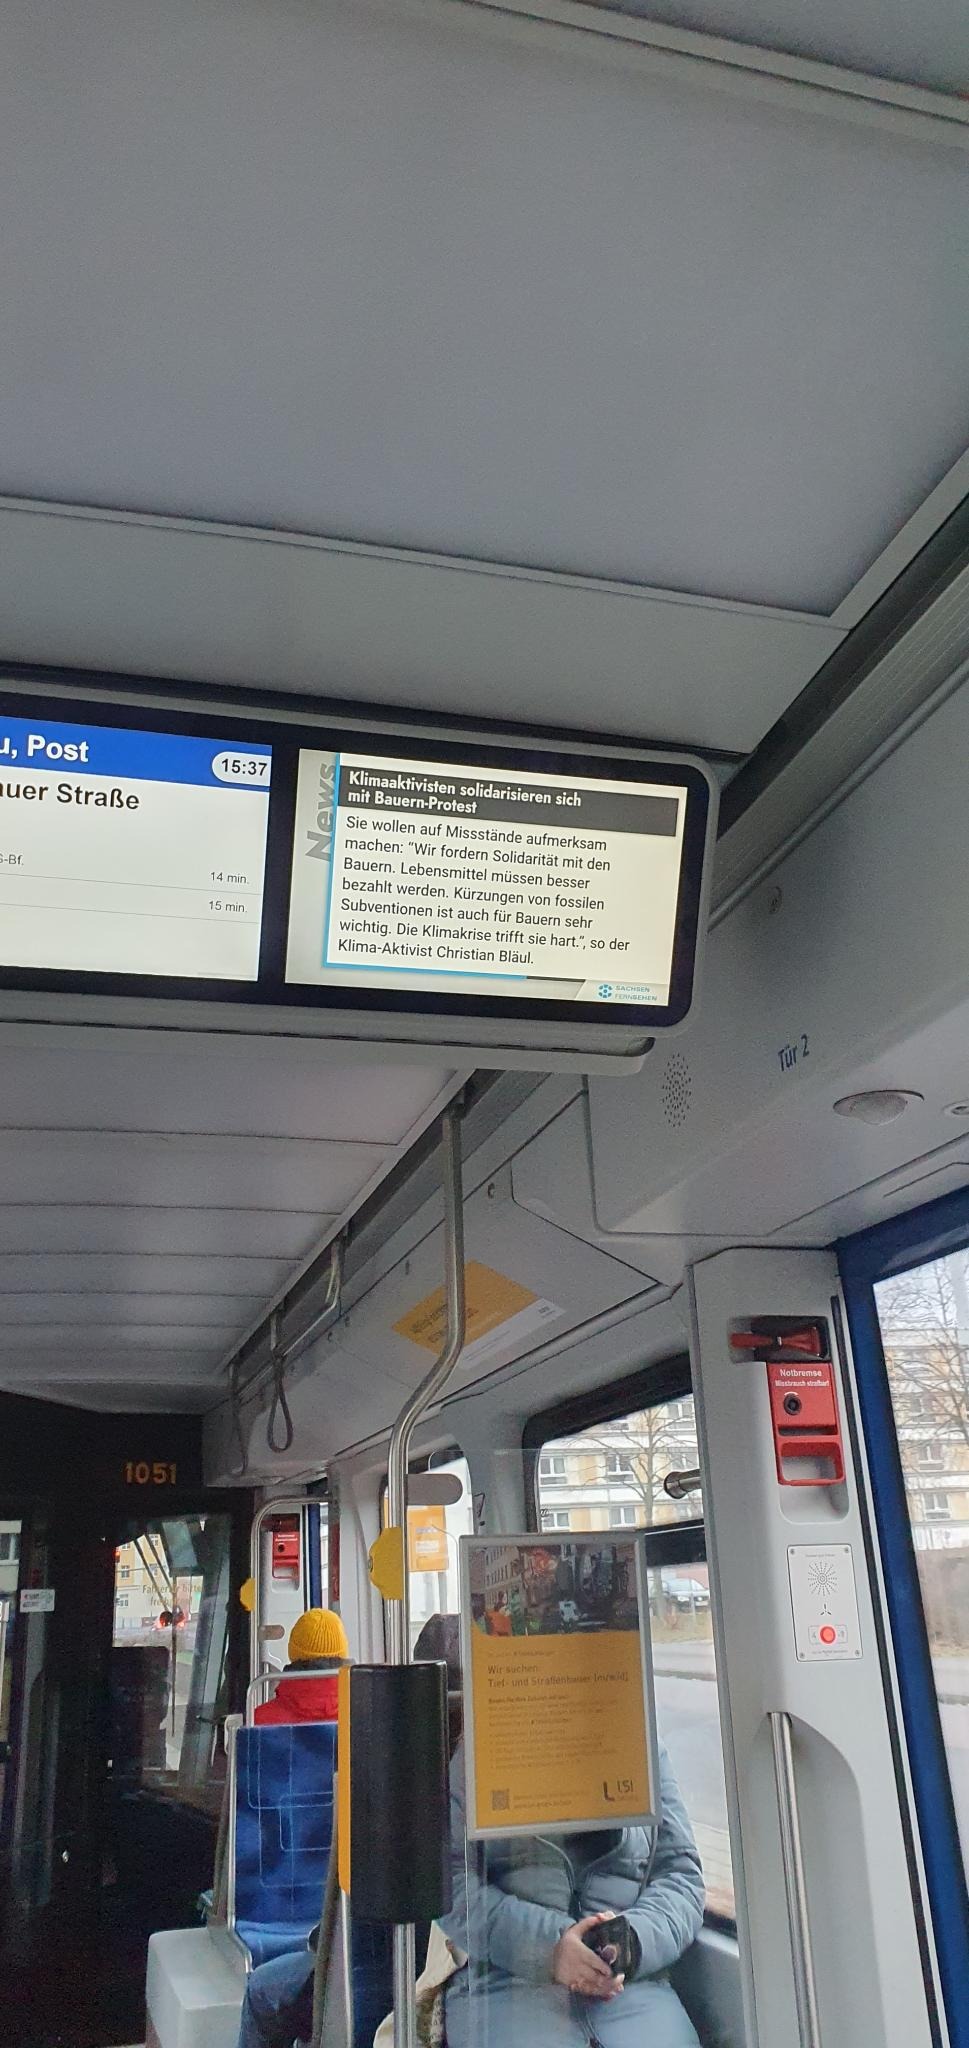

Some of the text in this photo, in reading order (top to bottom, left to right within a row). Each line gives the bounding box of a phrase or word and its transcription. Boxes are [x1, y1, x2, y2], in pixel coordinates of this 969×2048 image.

[27, 734, 90, 763] Post
[221, 758, 268, 777] 15:37
[0, 783, 140, 810] uer Straße
[348, 789, 477, 814] mit Bauern-Protest
[349, 771, 582, 807] Klimaaktivisten solidarisieren sich
[305, 763, 336, 862] News
[346, 816, 607, 851] Sie wollen auf Missstände aufmerksam
[345, 838, 403, 854] machen:
[441, 845, 488, 861] fordern
[492, 849, 559, 867] Solidarität
[562, 856, 583, 869] mit
[587, 857, 611, 871] den
[210, 871, 250, 885] 14 min.
[343, 857, 590, 889] Bauern. Lebensmittel müssen besser
[209, 901, 248, 913] 15 min.
[342, 877, 605, 910] bezahlt werden. Kürzungen von fossilen
[341, 898, 593, 929] Subventionen ist auch für Bauern sehr
[339, 919, 392, 937] wichtig.
[397, 922, 418, 936] Die
[422, 925, 492, 942] Klimakrise
[495, 929, 525, 944] trifft
[528, 933, 547, 946] sie
[590, 938, 606, 950] so
[609, 937, 630, 951] der
[338, 938, 534, 965] Klima-Aktivist Christian Bläul.
[615, 985, 650, 993] SACHSEN
[615, 993, 658, 1002] FERNSEHEN
[778, 1033, 810, 1072] Tür 2
[780, 1368, 823, 1377] Notbremse
[123, 1461, 177, 1485] 1051
[488, 1665, 503, 1675] Wir
[488, 1677, 509, 1688] Tief-
[511, 1677, 529, 1688] und
[531, 1673, 591, 1687] Straßenbauer
